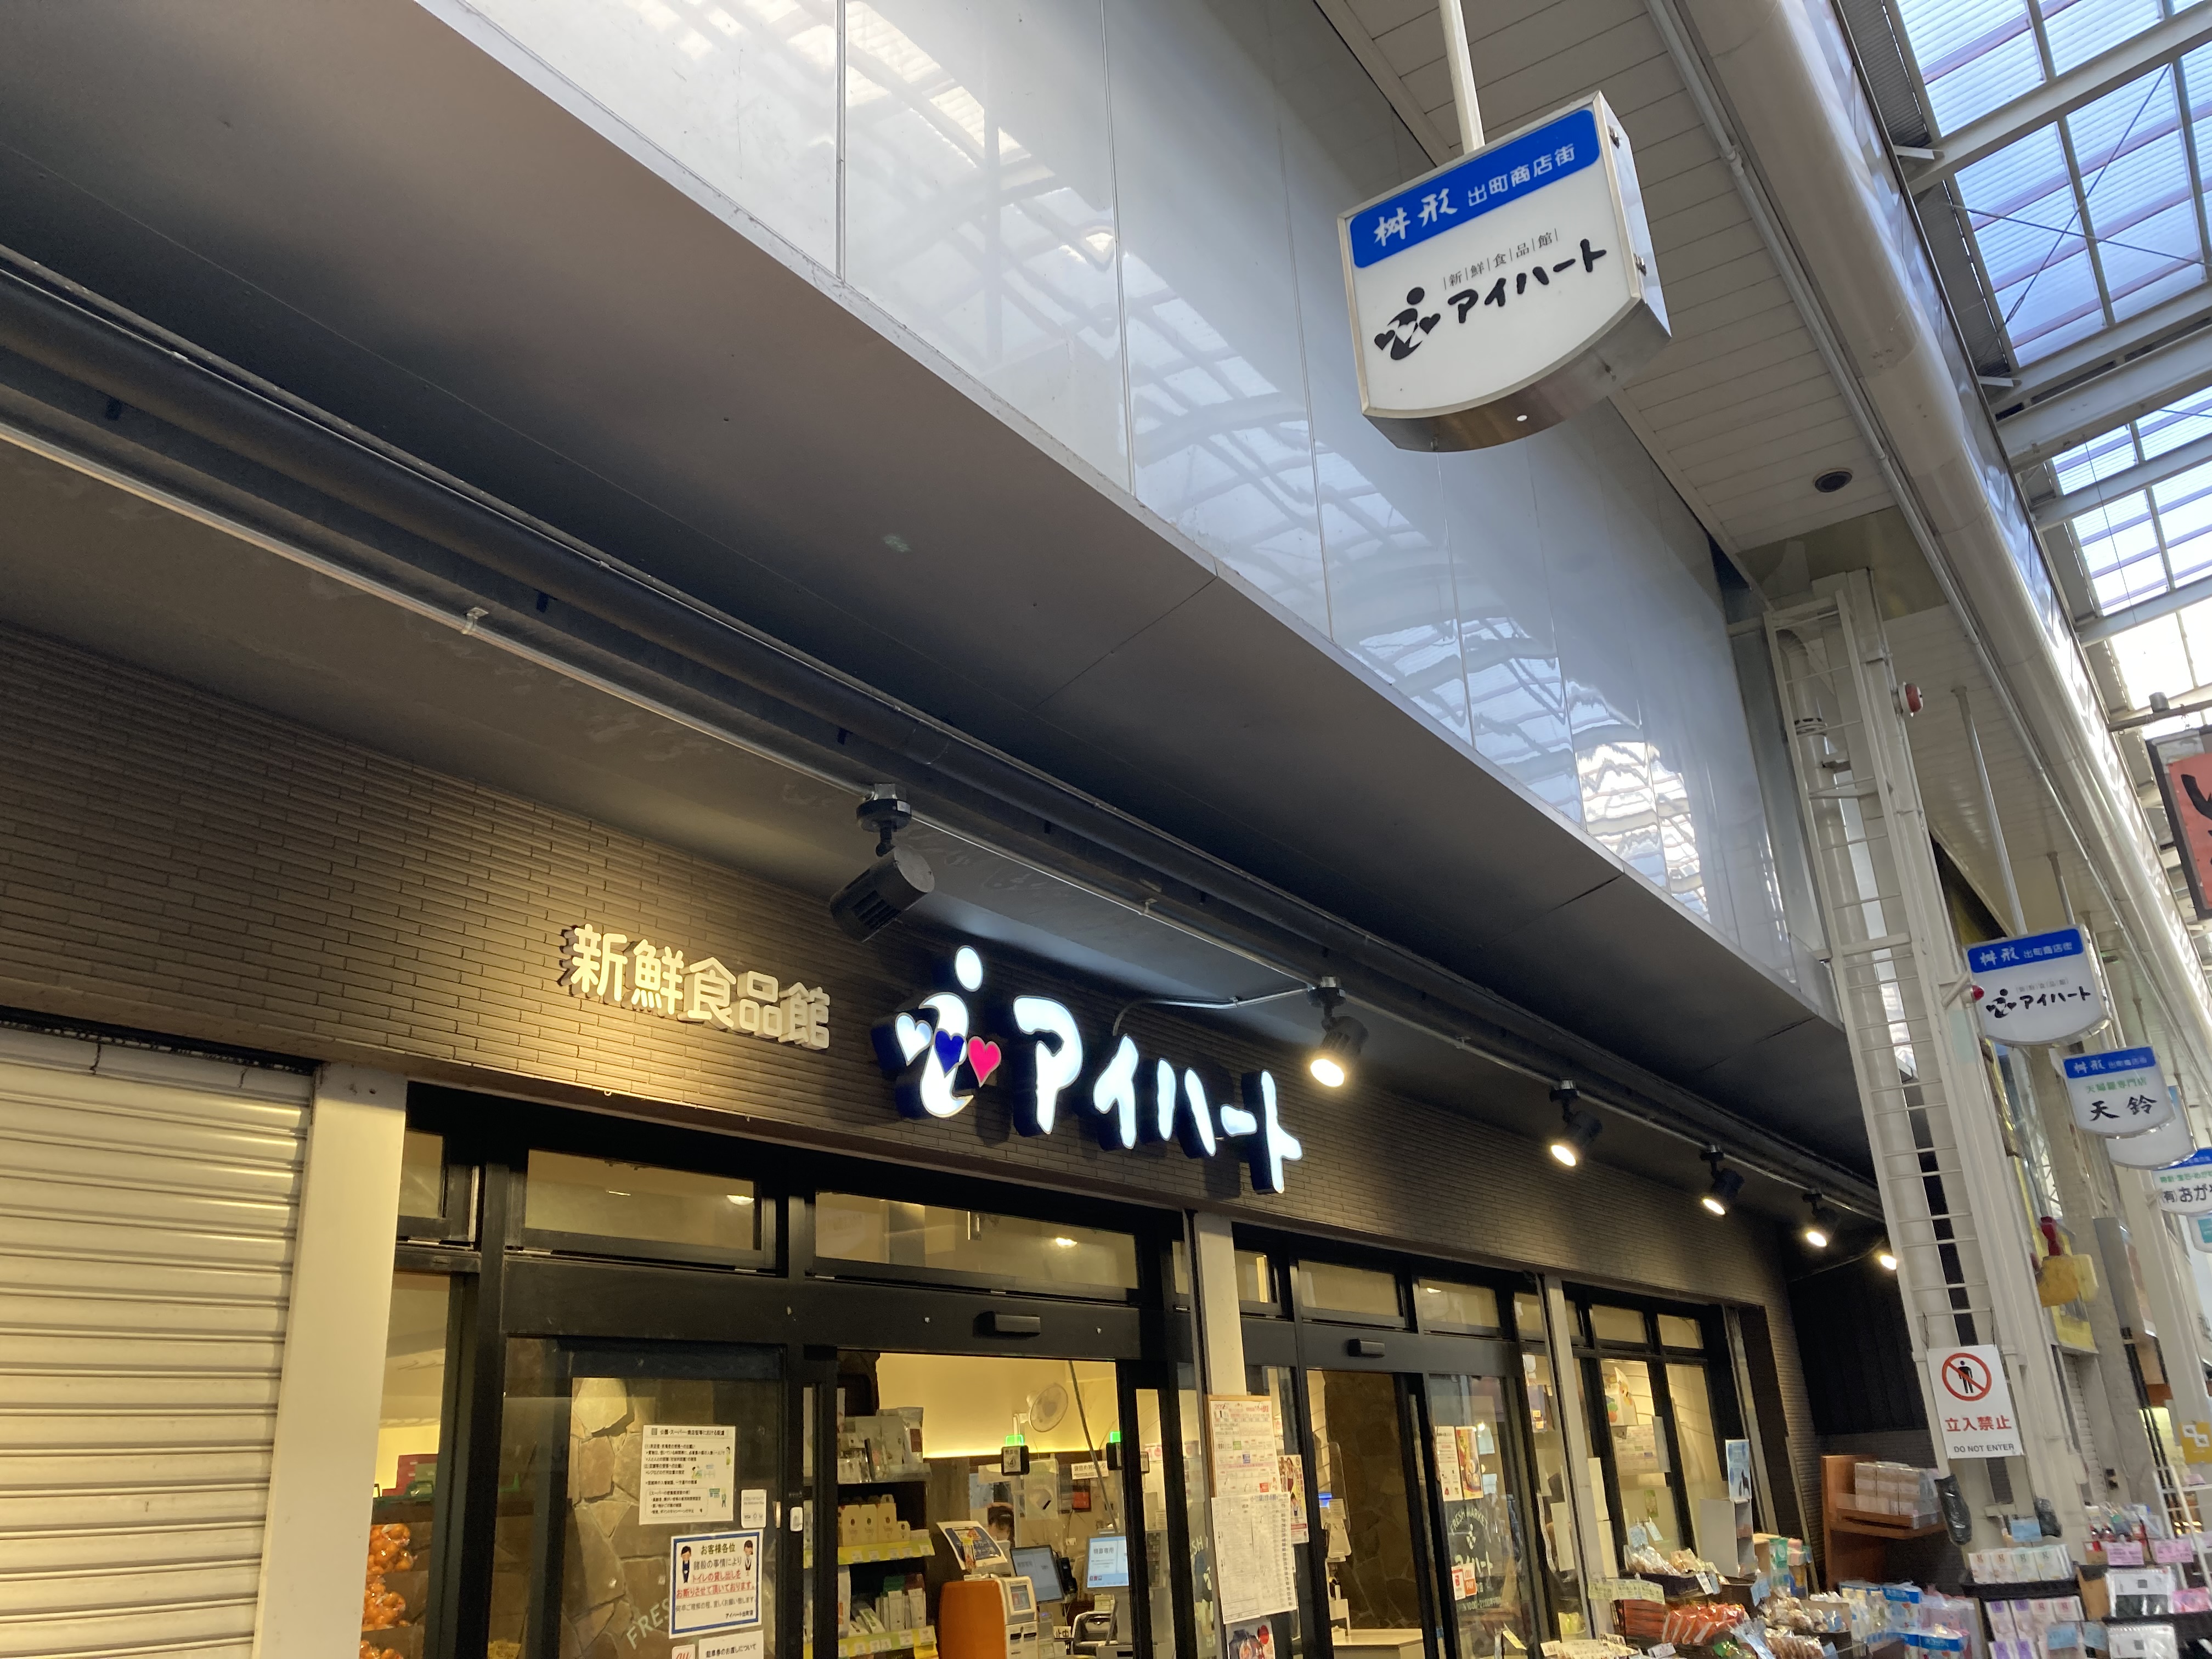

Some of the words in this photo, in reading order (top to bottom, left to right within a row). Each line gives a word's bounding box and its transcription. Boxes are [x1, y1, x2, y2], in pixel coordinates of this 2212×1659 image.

[1467, 143, 1576, 207] 出町商店街
[1447, 238, 1607, 324] アイハート
[571, 923, 831, 1049] 新鮮食品館
[2019, 986, 2091, 1009] アイハート
[1012, 995, 1302, 1194] アイハート
[1944, 1414, 2012, 1432] 立入禁止
[1986, 1443, 2015, 1452] ENTER
[1450, 1509, 1466, 1536] FRESH
[1466, 1507, 1489, 1530] MARKET
[701, 1542, 736, 1555] お客様各位
[693, 1556, 742, 1571] 諸般の事情により
[692, 1569, 741, 1583] トイレの貸し出しを
[1466, 1581, 1475, 1590] PAY
